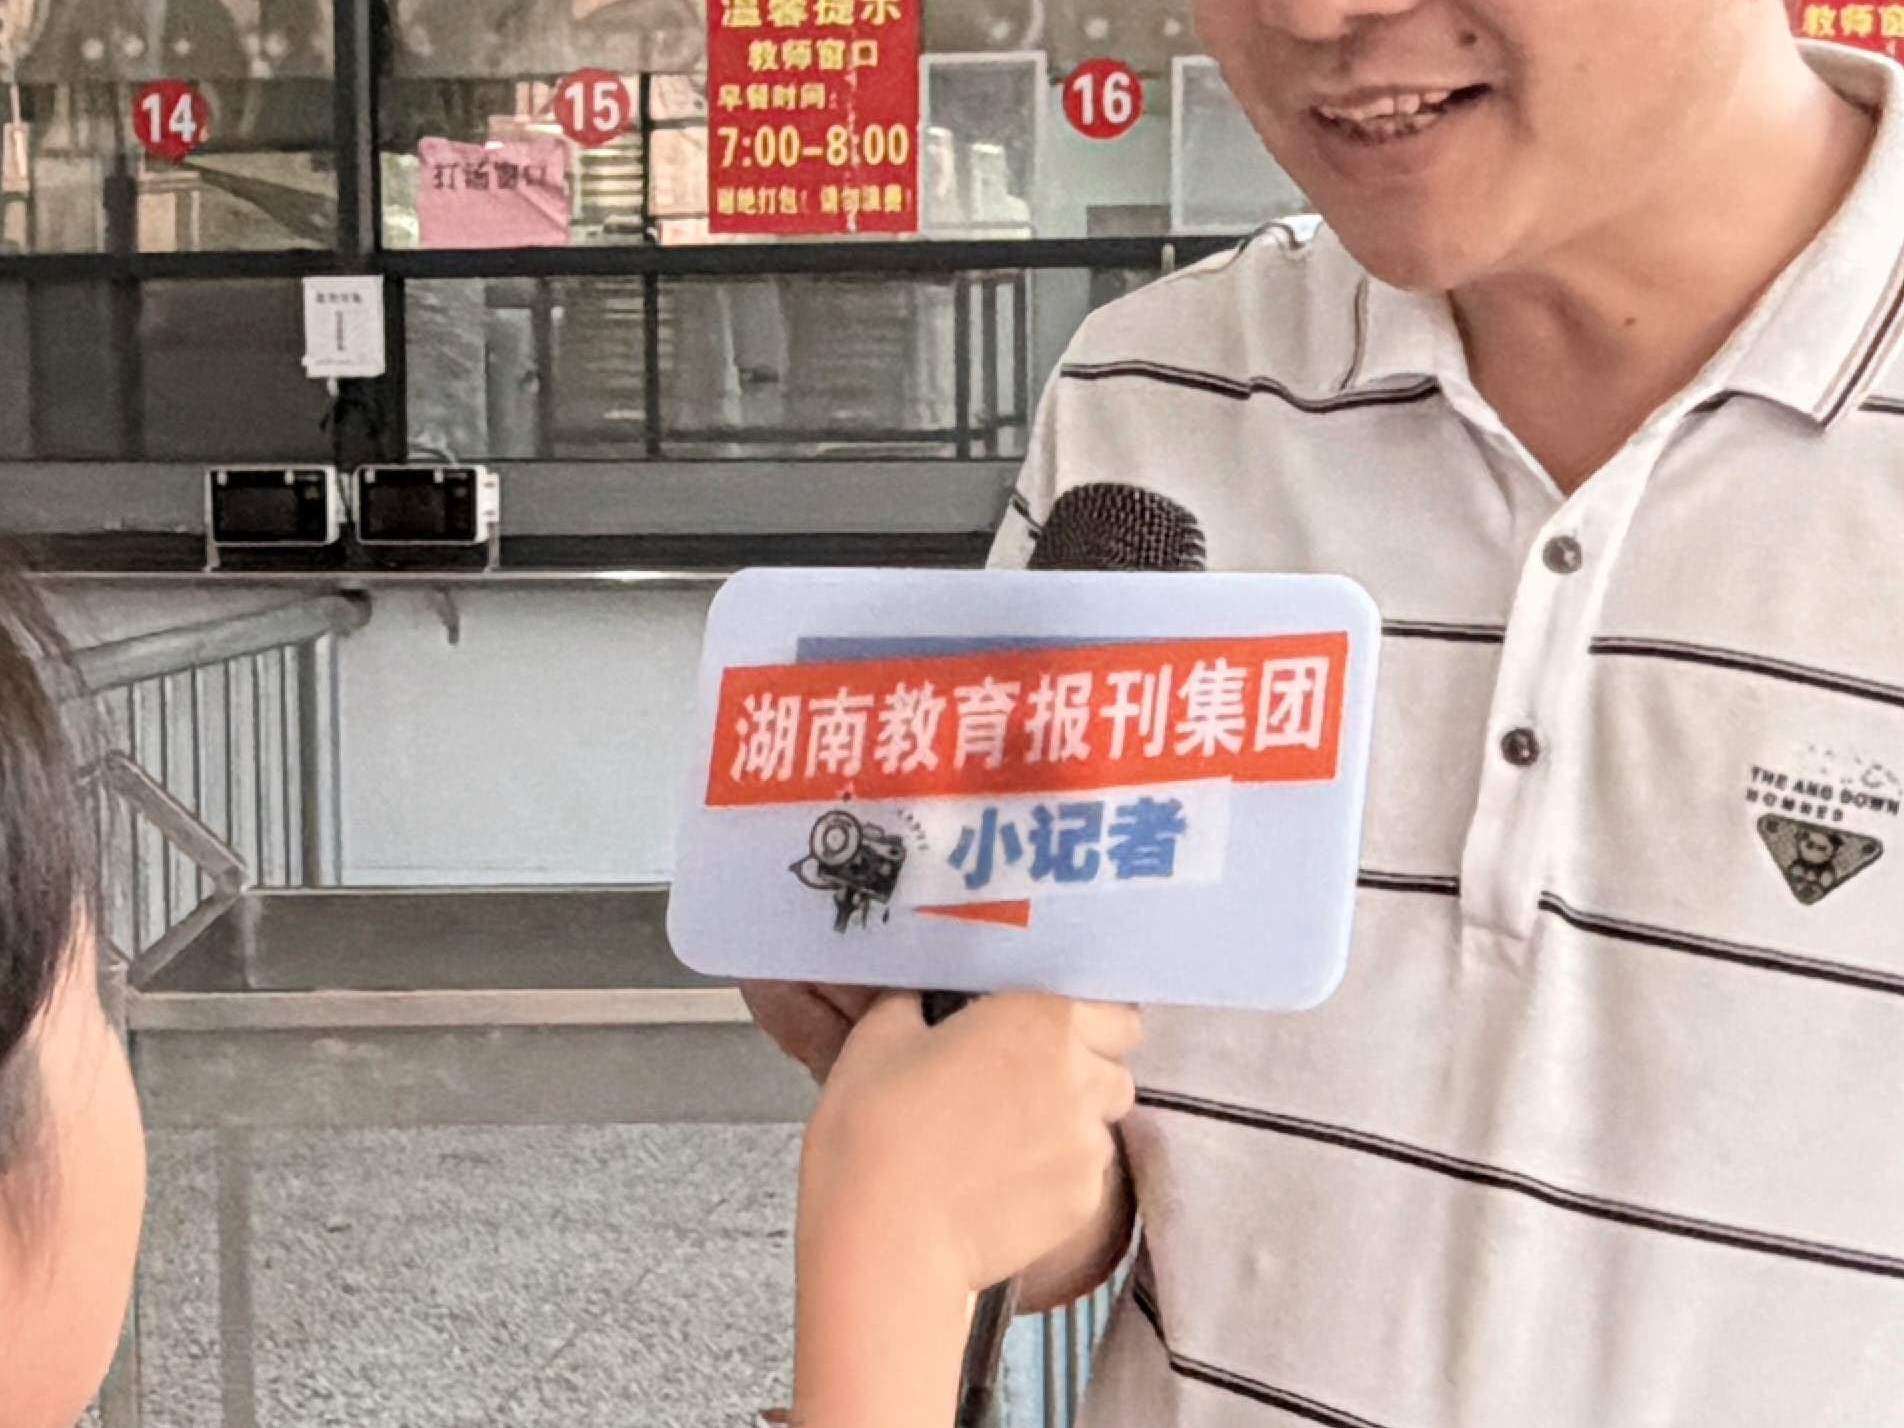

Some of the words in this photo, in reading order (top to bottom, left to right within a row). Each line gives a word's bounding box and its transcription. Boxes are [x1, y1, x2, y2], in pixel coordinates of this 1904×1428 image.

[747, 38, 879, 71] 教师窗口
[141, 94, 198, 142] 14
[563, 78, 621, 132] 15
[1071, 73, 1133, 125] 16
[728, 655, 1331, 784] 湖南教育报刊集团
[947, 795, 1188, 890] 小记者
